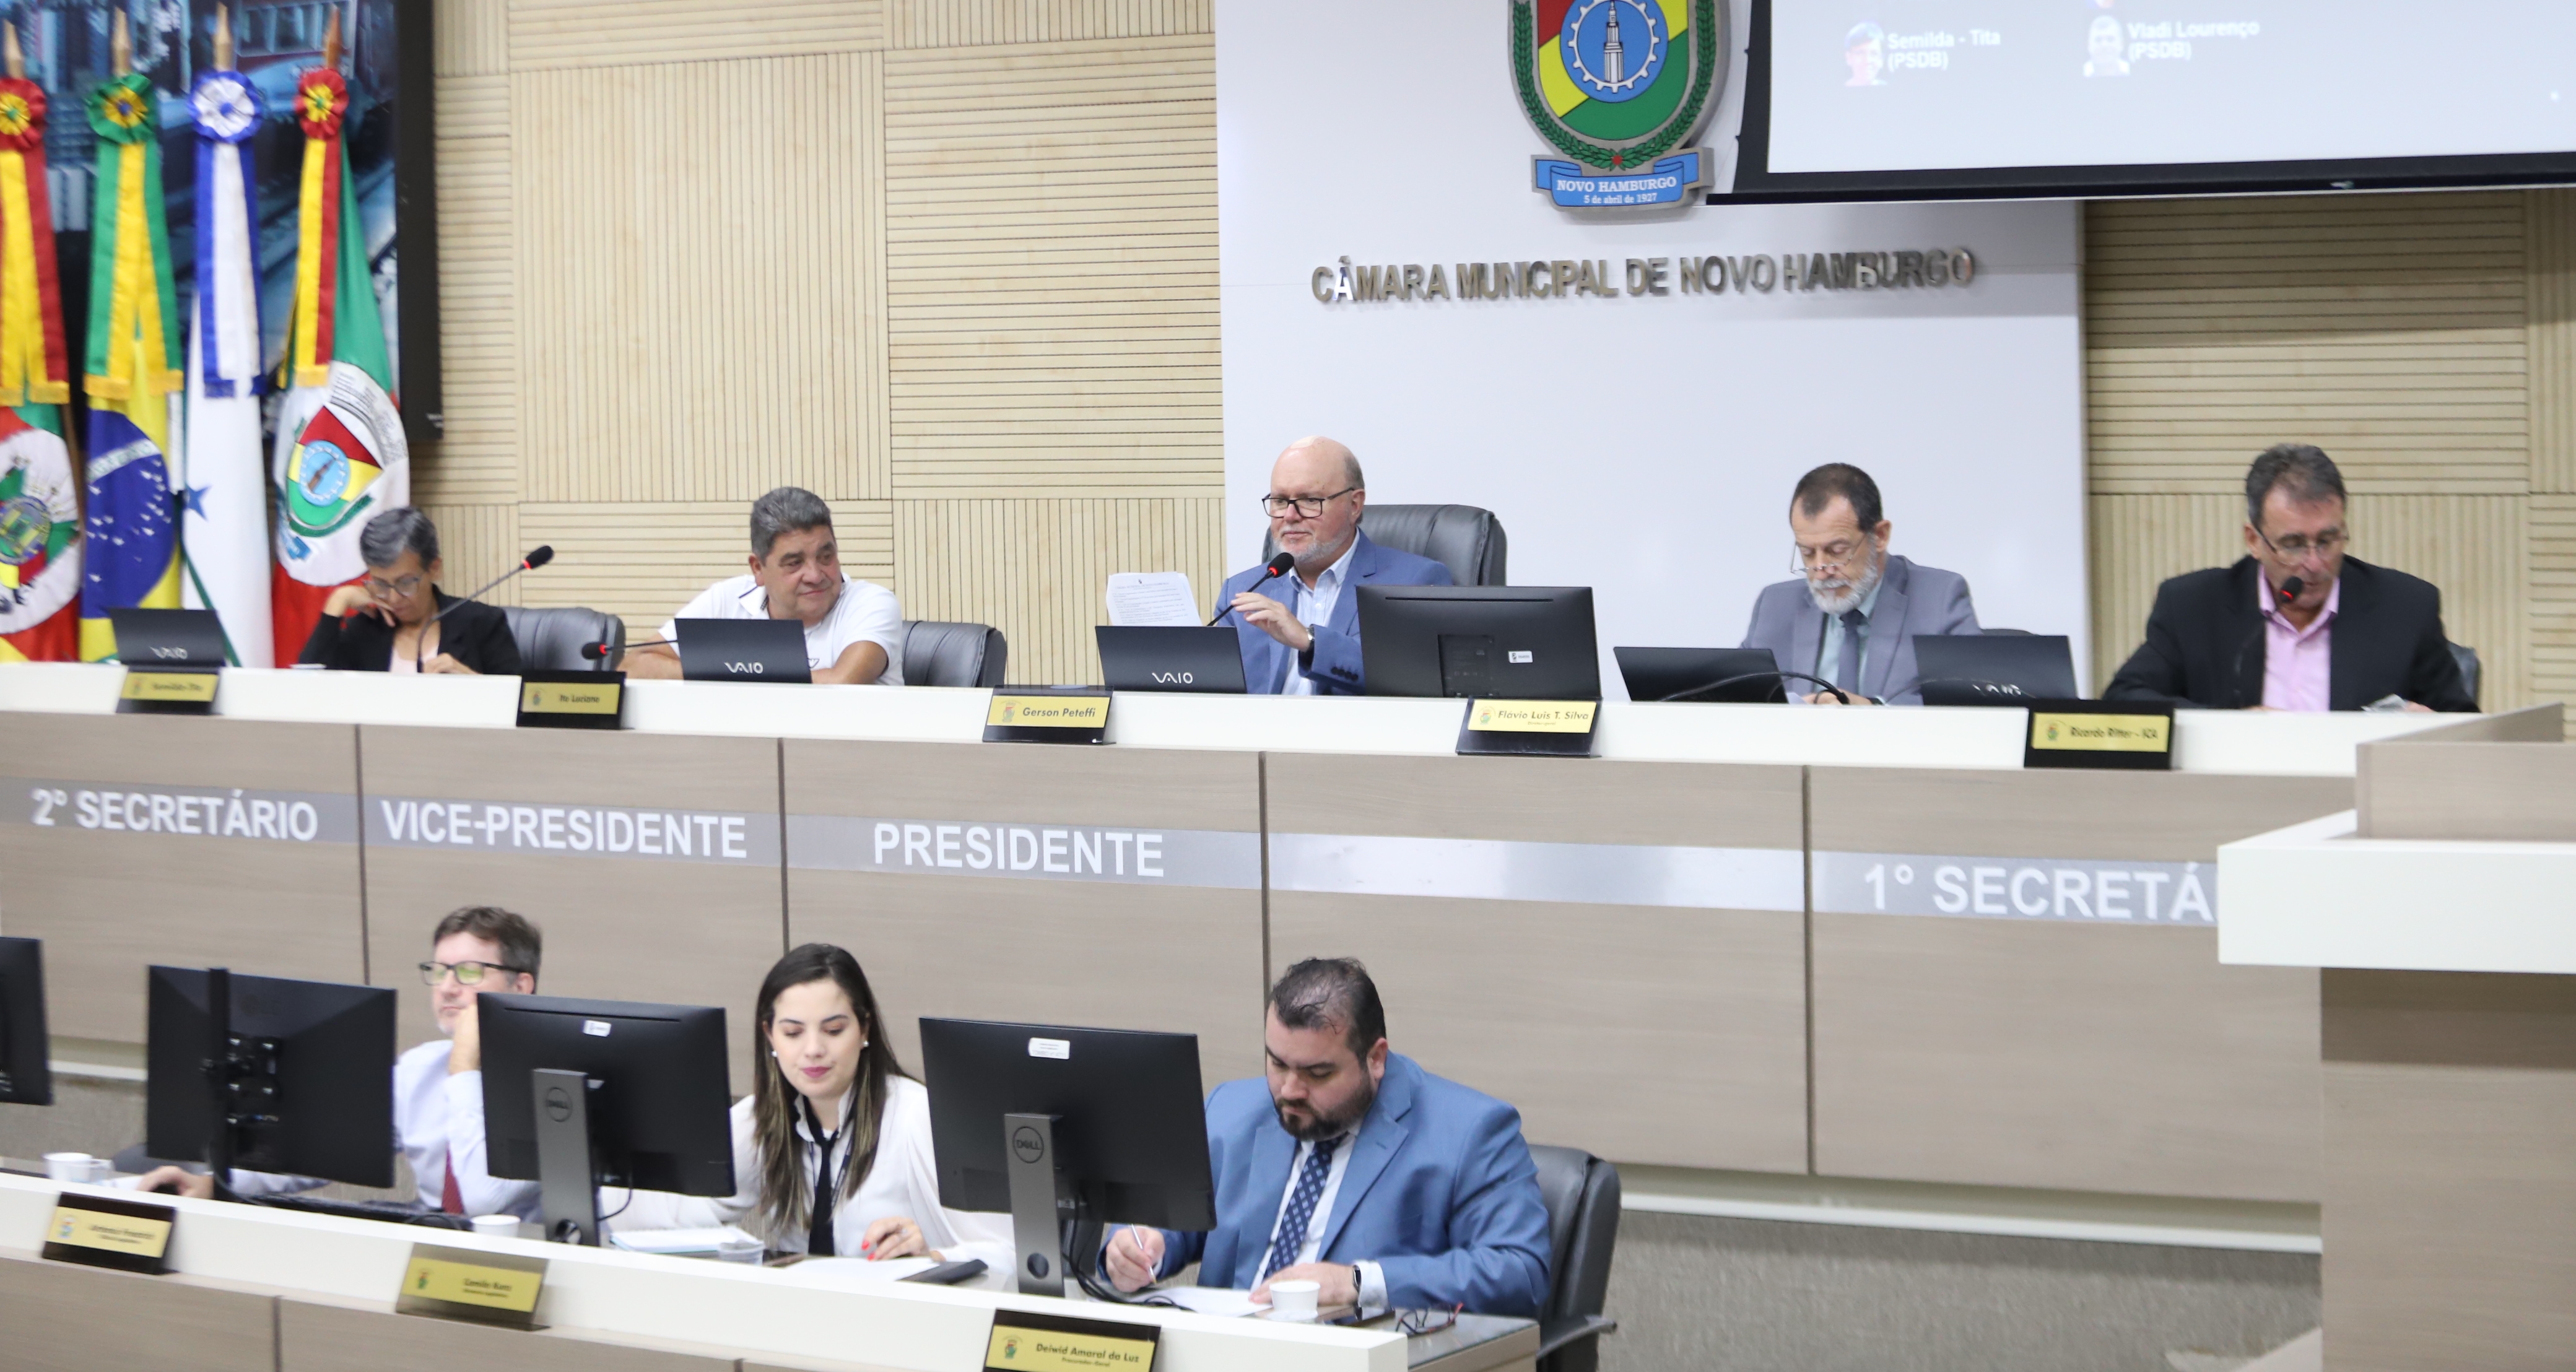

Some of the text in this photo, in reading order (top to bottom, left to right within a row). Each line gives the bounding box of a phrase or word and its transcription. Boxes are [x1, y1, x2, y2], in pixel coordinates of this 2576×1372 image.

[2175, 20, 2261, 40] Lourenço
[1887, 31, 1955, 50] Semilda
[1969, 29, 2001, 46] Tita
[1888, 50, 1949, 72] (PSDB)
[2128, 41, 2192, 63] (PSDB)
[1557, 176, 1677, 193] NOVO HAMBURGO
[1583, 193, 1658, 204] 5 de abril de 1927
[1311, 248, 1975, 302] CÂMARA MUNICIPAL DE NOVO HAMBURGO
[724, 662, 764, 674] VAIO
[1152, 672, 1193, 684] VAIO
[572, 694, 600, 703] Luciano
[1022, 707, 1096, 718] Gerson Peteffi
[1499, 710, 1589, 720] Flávio Luis T. Silva
[2070, 726, 2104, 737] Ricardo
[75, 789, 319, 841] SECRETÁRIO
[380, 800, 747, 858] VICE-PRESIDENTE
[874, 823, 1164, 877] PRESIDENTE
[1016, 1139, 1042, 1150] DELL
[1036, 1343, 1068, 1355] Deiwid
[1070, 1347, 1106, 1359] Amaral
[1124, 1352, 1139, 1363] Luz
